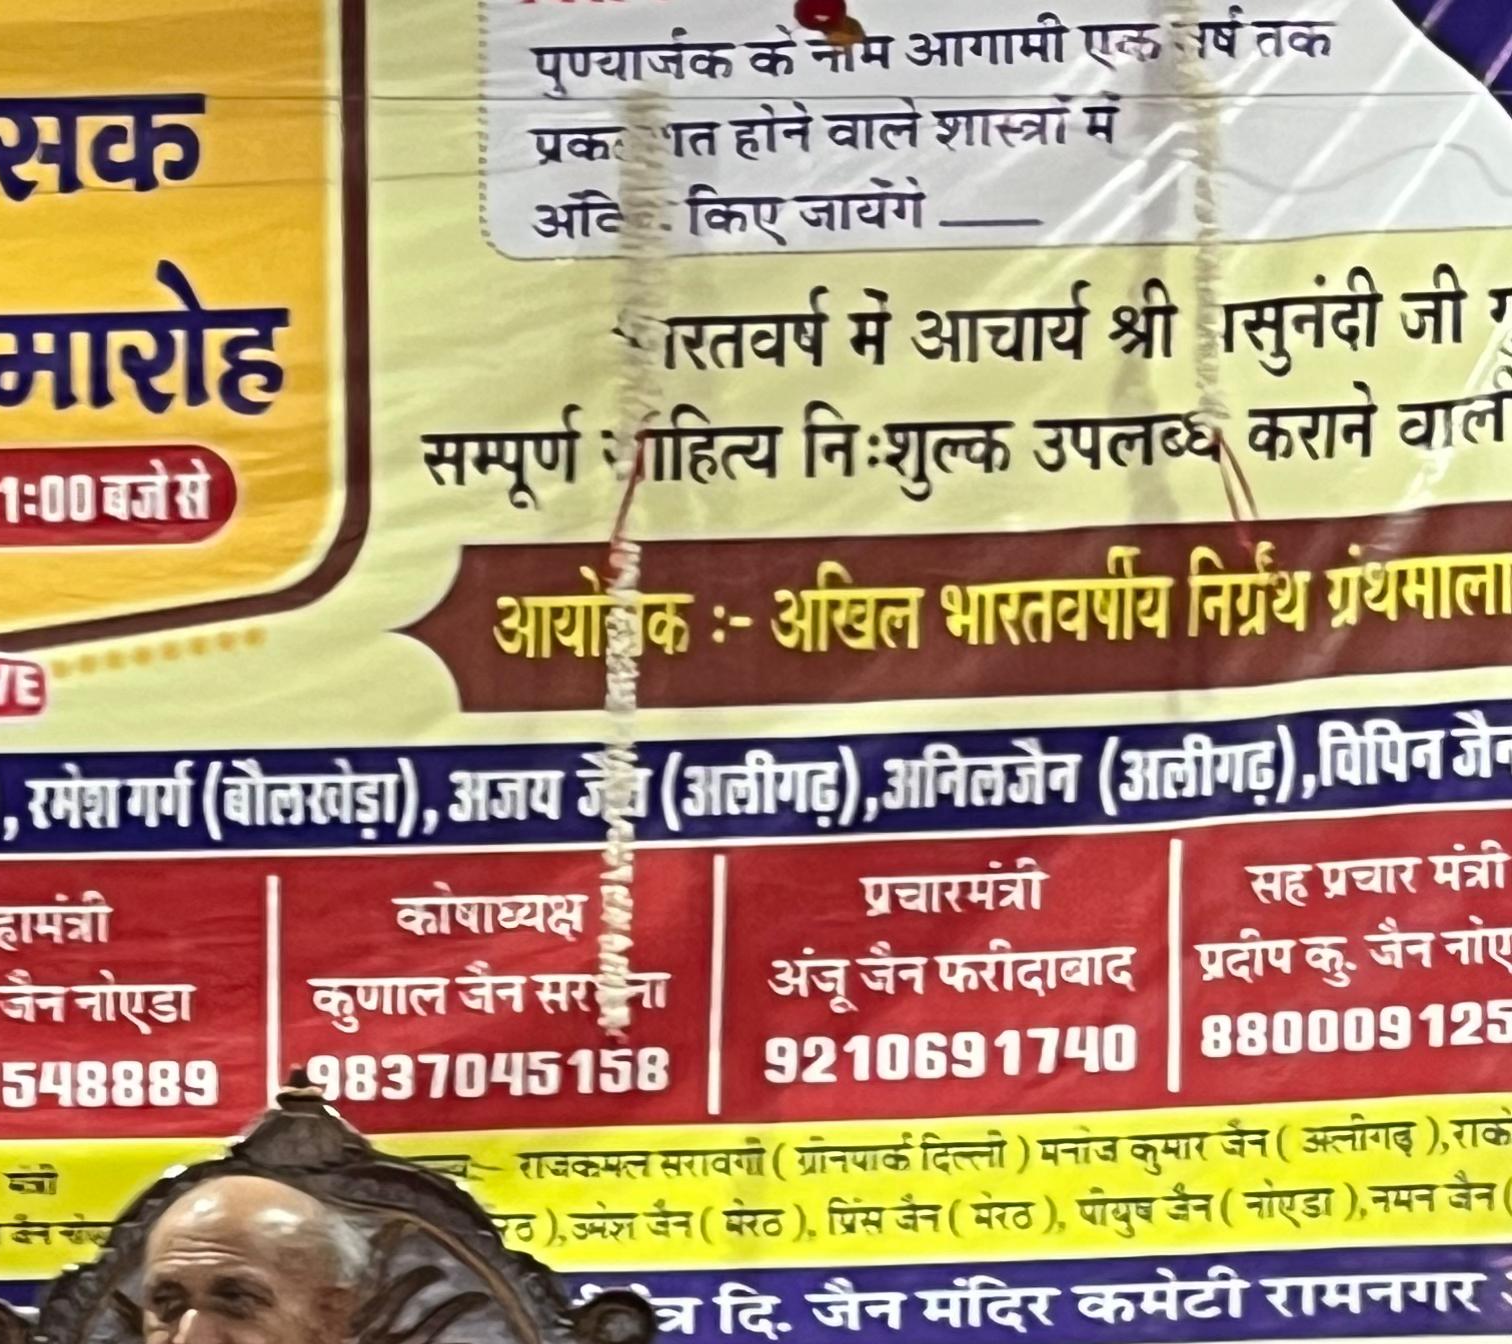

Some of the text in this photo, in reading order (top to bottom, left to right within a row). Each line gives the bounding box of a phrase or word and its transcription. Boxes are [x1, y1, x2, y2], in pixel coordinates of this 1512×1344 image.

[744, 24, 797, 77] के
[806, 36, 894, 73] नाम
[906, 12, 1069, 67] आगामी
[1252, 21, 1336, 57] तक
[728, 102, 813, 160] होने
[822, 97, 922, 150] वाले
[684, 183, 787, 246] किए
[910, 280, 1091, 363] आचार्य
[1109, 277, 1179, 358] श्री
[1400, 263, 1468, 344] जी
[422, 403, 581, 507] सम्पूर्ण
[1248, 380, 1378, 462] कराने
[100, 458, 169, 521] बजे
[174, 458, 212, 520] से
[770, 560, 923, 651] अखिल
[941, 546, 1175, 646] भारतवर्षीय
[1324, 543, 1512, 629] ग्रंथमाला
[449, 770, 565, 822] अजय
[1317, 718, 1446, 787] विपिन
[1244, 839, 1512, 907] सह प्रचार मंत्री
[767, 938, 1138, 1014] अंजू जैन फरीदाबाद
[1193, 928, 1297, 984] प्रदीप
[1363, 916, 1437, 969] जैन
[70, 969, 197, 1036] नोएडा
[306, 960, 672, 1034] कुणाल जैन सरना
[307, 1046, 670, 1102] 9837045158
[764, 1024, 1138, 1084] 9210691740
[804, 1277, 908, 1331] जैन
[914, 1274, 1062, 1334] मंदिर
[1071, 1264, 1251, 1325] कमेटी
[1259, 1272, 1488, 1319] रामनगर
